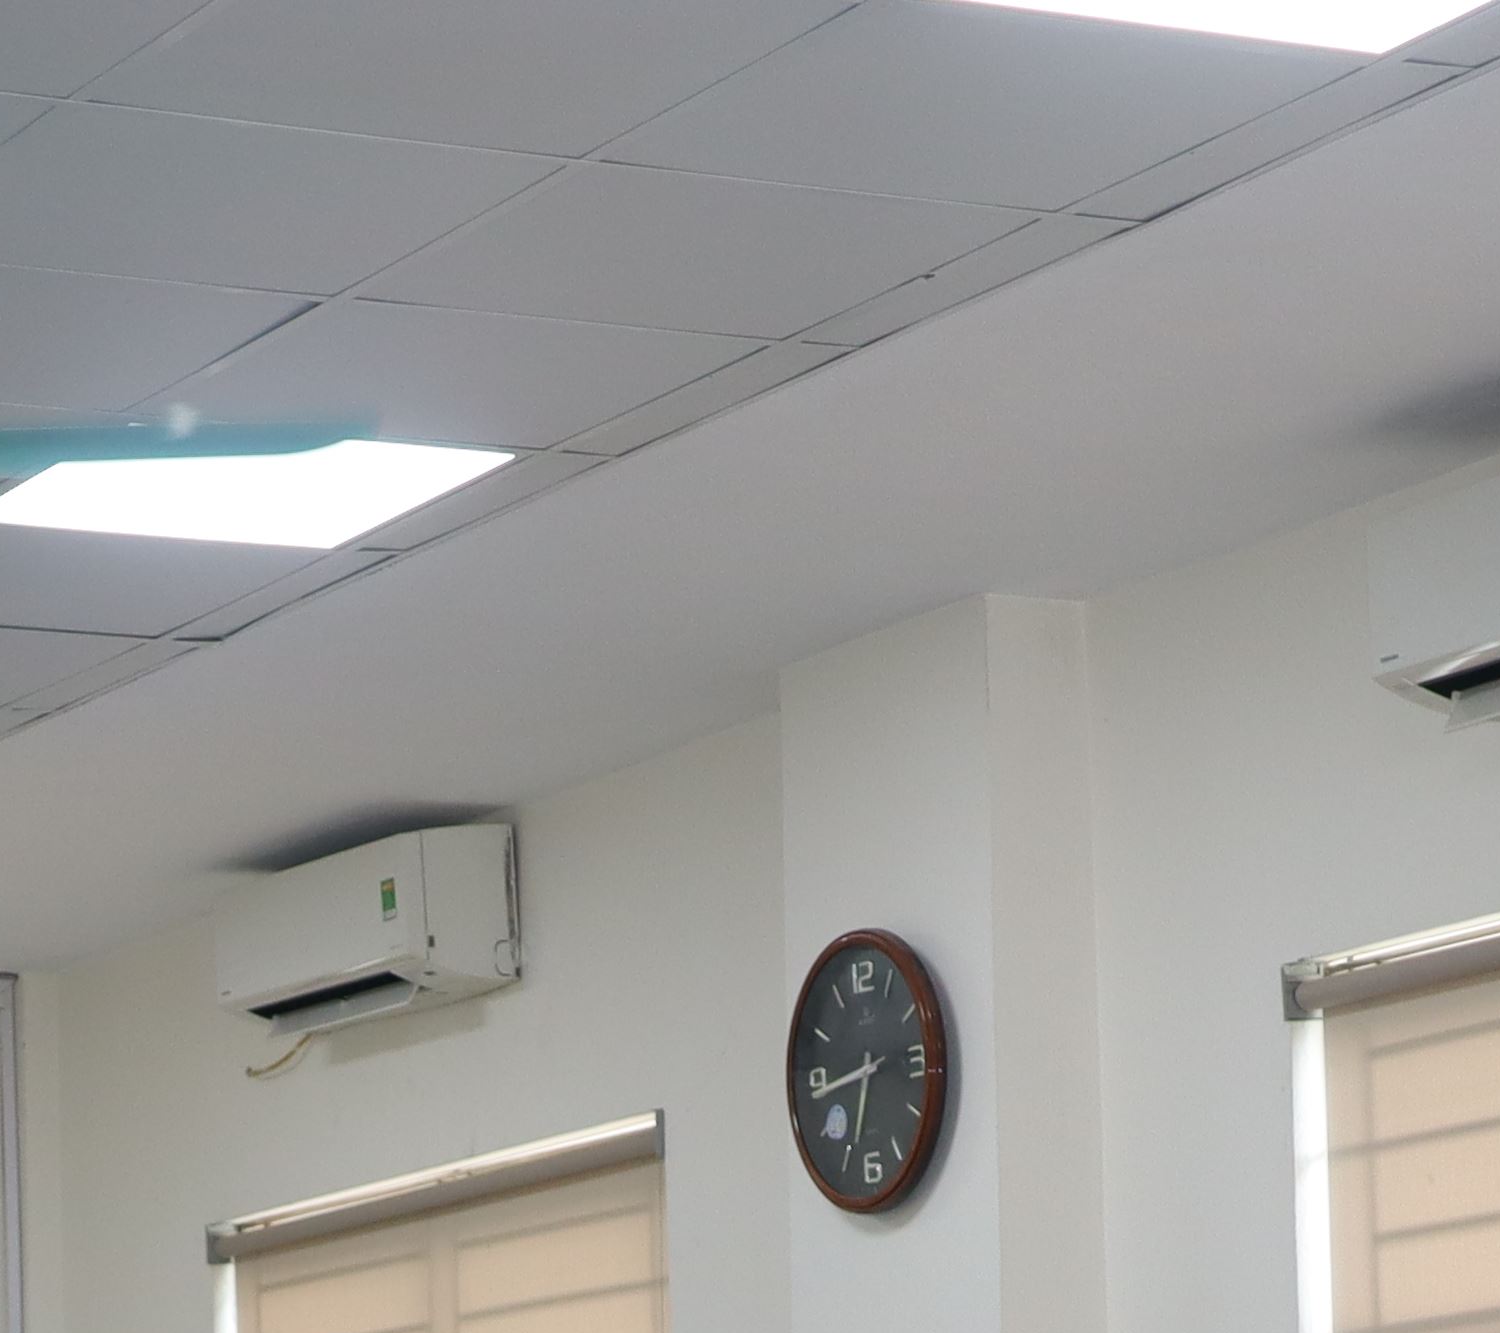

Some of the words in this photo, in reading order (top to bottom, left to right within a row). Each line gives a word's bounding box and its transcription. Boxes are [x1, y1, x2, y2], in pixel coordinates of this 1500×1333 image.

[851, 960, 875, 994] 12
[907, 1044, 925, 1079] 3
[809, 1066, 828, 1098] 9
[863, 1150, 883, 1184] 6
